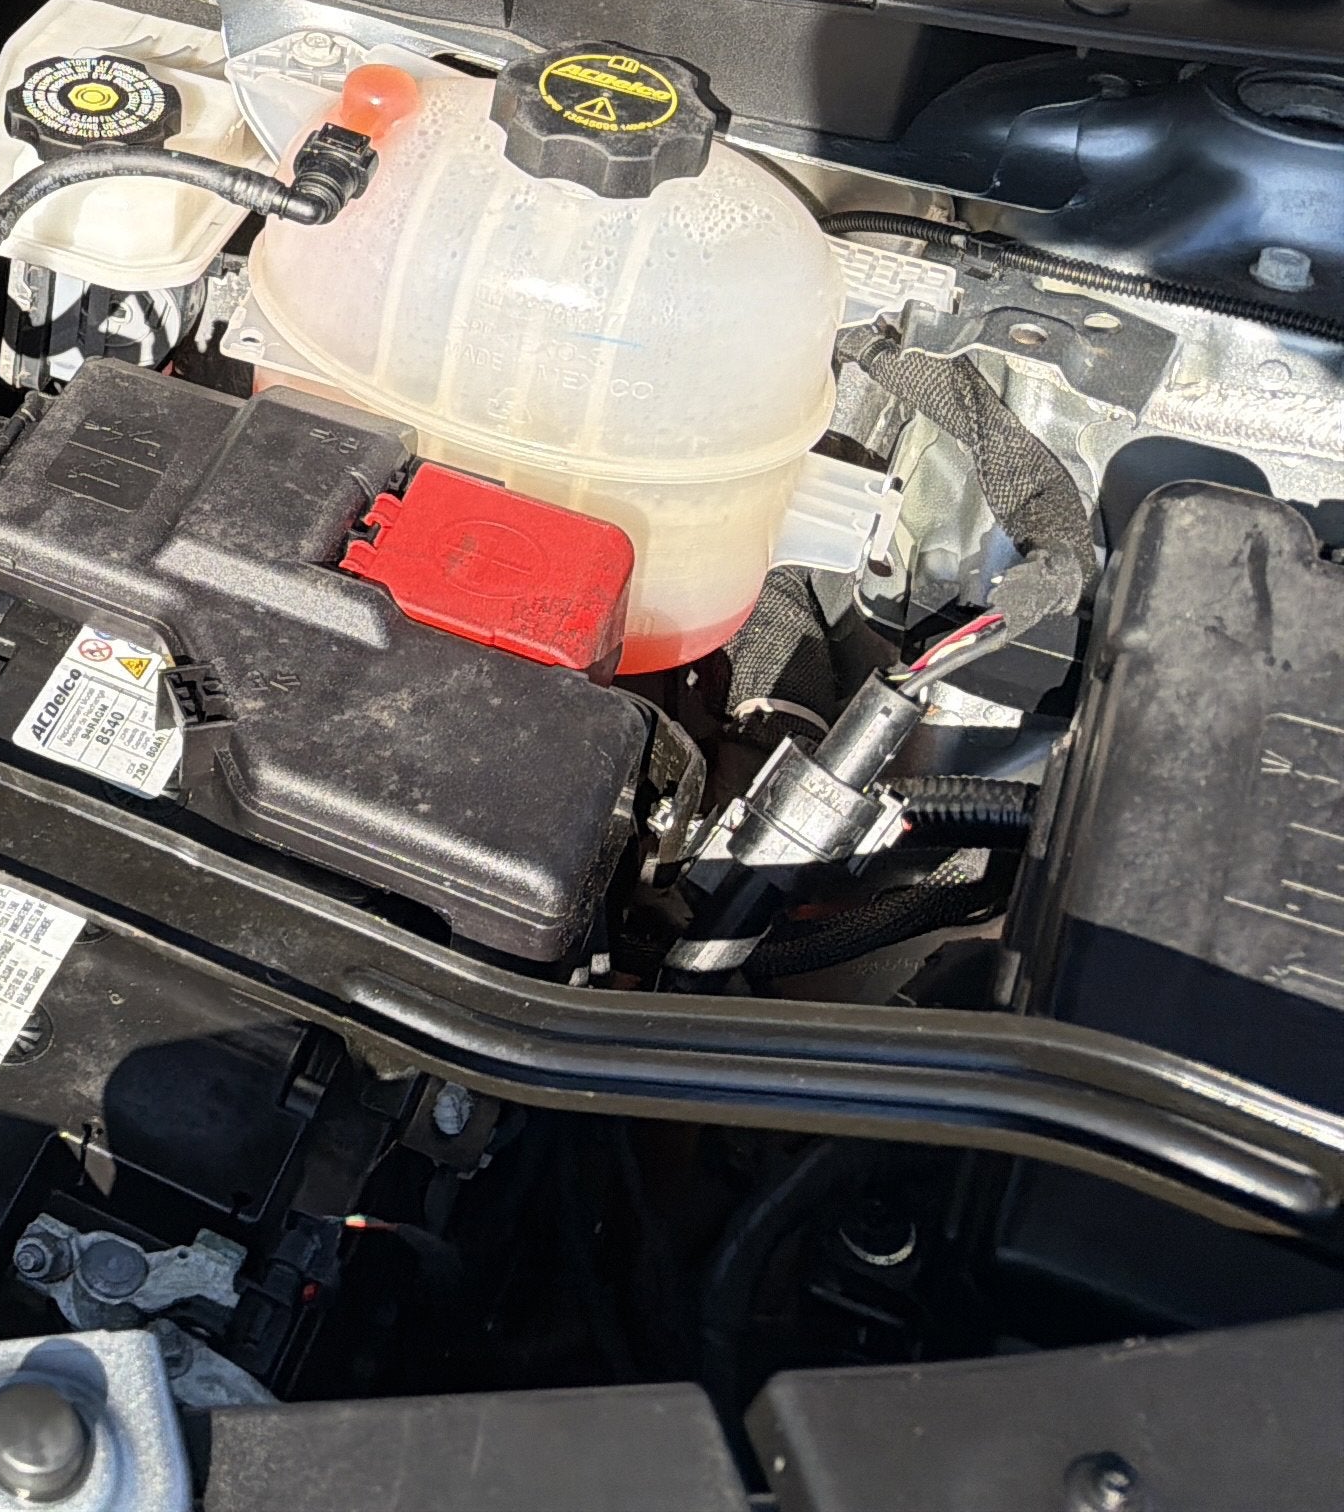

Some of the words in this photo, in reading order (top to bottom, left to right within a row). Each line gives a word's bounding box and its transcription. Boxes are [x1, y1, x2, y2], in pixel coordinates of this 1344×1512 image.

[555, 64, 671, 100] ACDelco
[31, 668, 83, 741] ACDelco
[81, 703, 108, 740] 94RAGM
[94, 708, 125, 746] 8540
[132, 761, 149, 781] 730
